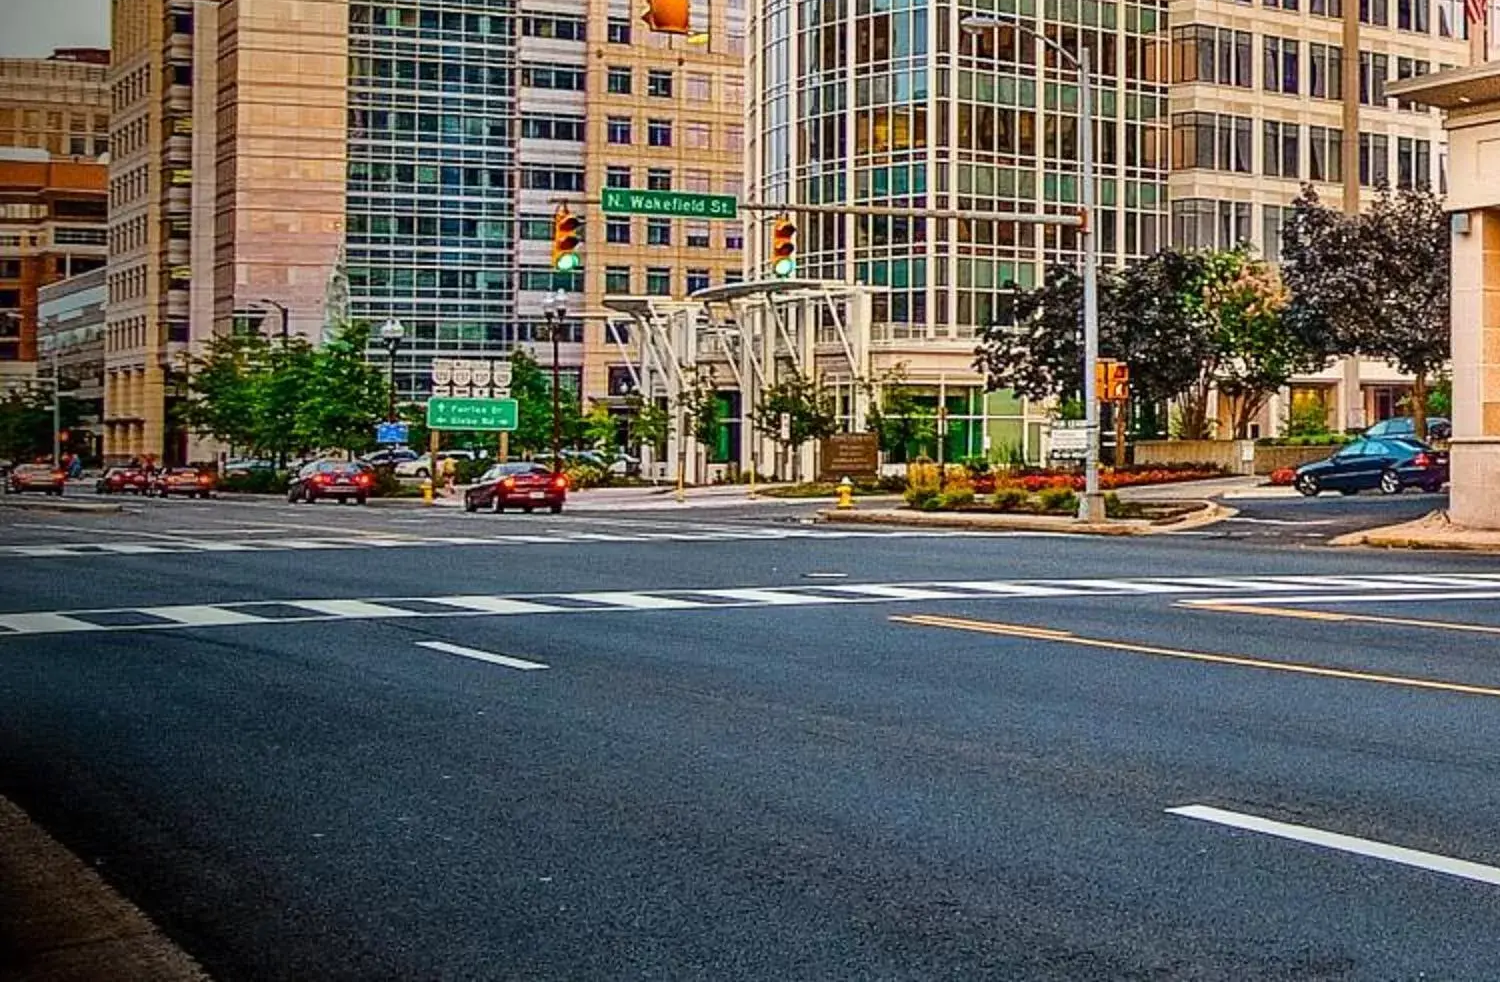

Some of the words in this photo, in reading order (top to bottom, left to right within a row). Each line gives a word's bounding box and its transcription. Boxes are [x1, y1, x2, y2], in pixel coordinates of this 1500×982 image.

[607, 193, 625, 208] N.
[630, 195, 705, 213] Wakefield
[709, 199, 733, 214] St.
